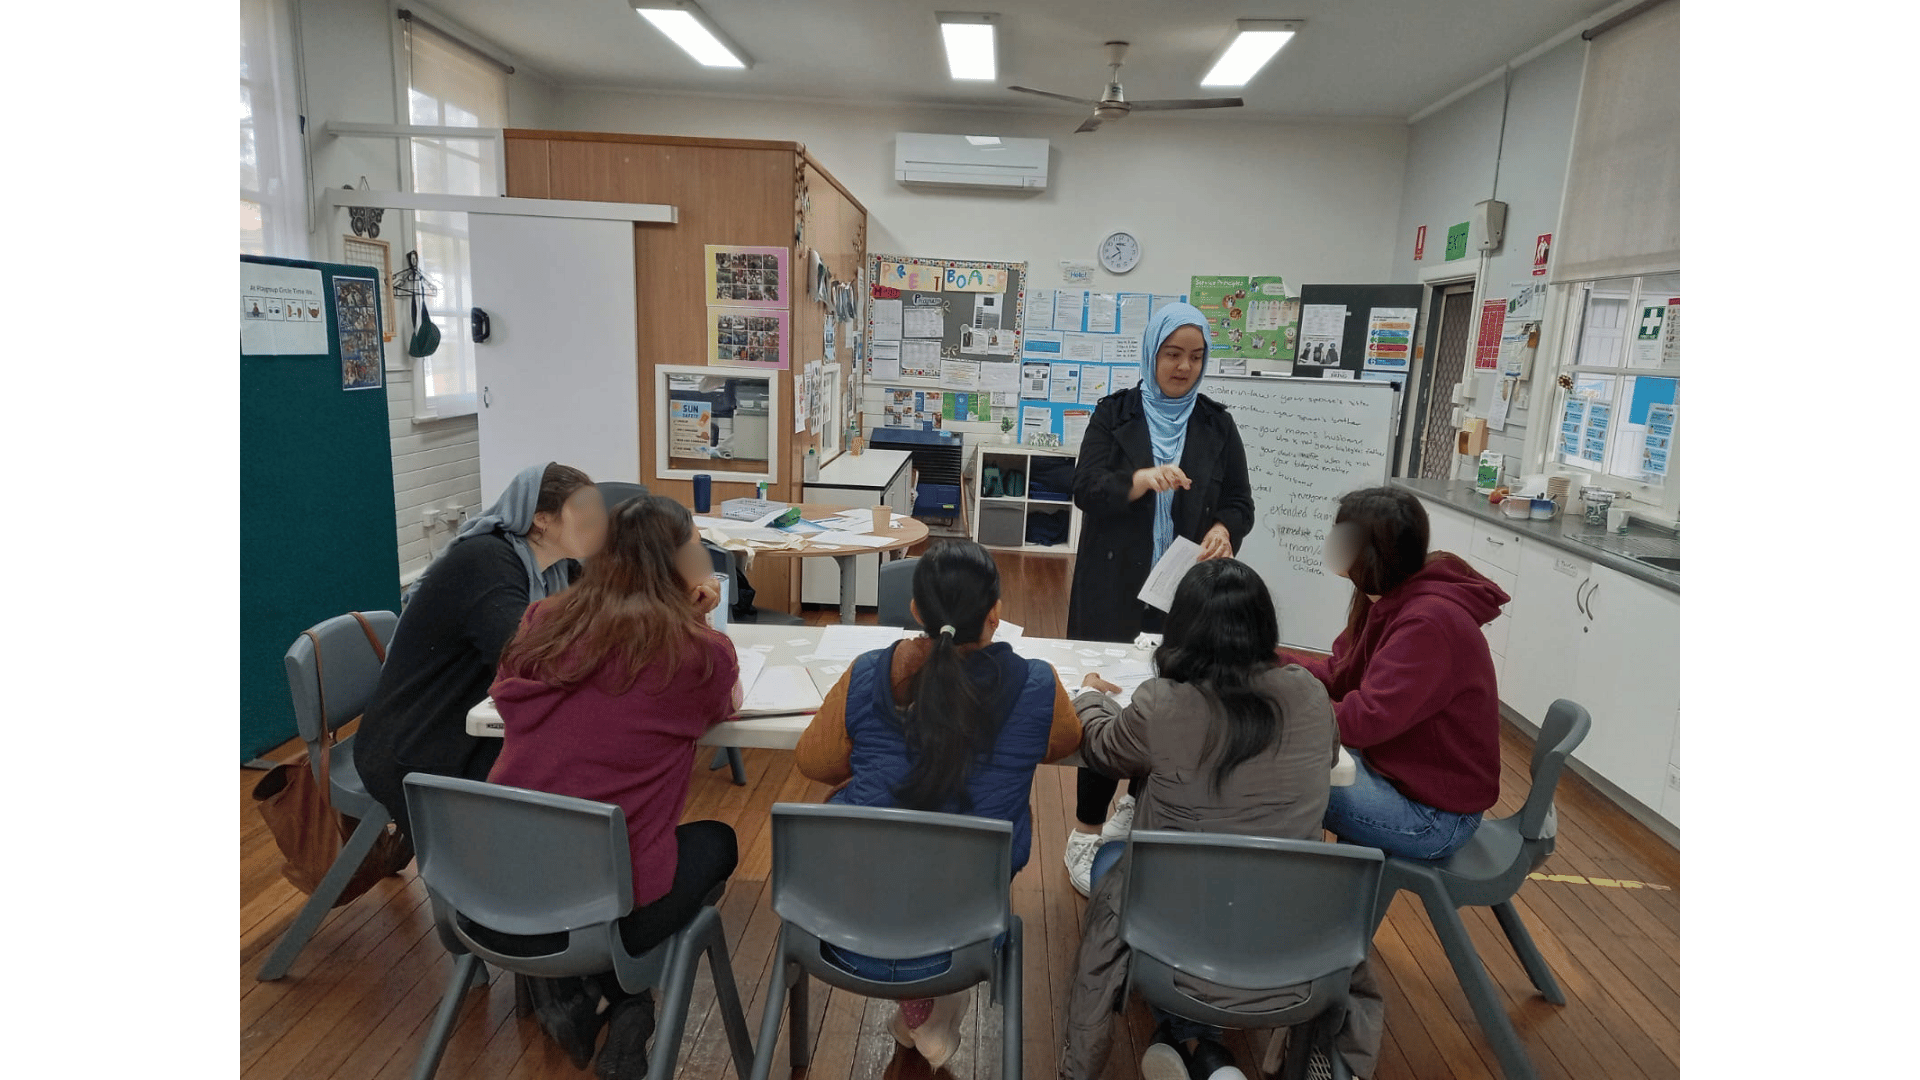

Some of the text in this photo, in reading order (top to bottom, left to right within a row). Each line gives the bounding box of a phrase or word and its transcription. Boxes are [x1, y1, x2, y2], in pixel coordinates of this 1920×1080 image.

[1448, 232, 1466, 250] EXIT
[882, 264, 941, 291] PRET
[1280, 394, 1304, 404] your
[682, 404, 699, 413] SUN
[1258, 425, 1280, 438] your
[1285, 427, 1318, 439] mom's
[1270, 503, 1308, 518] extended
